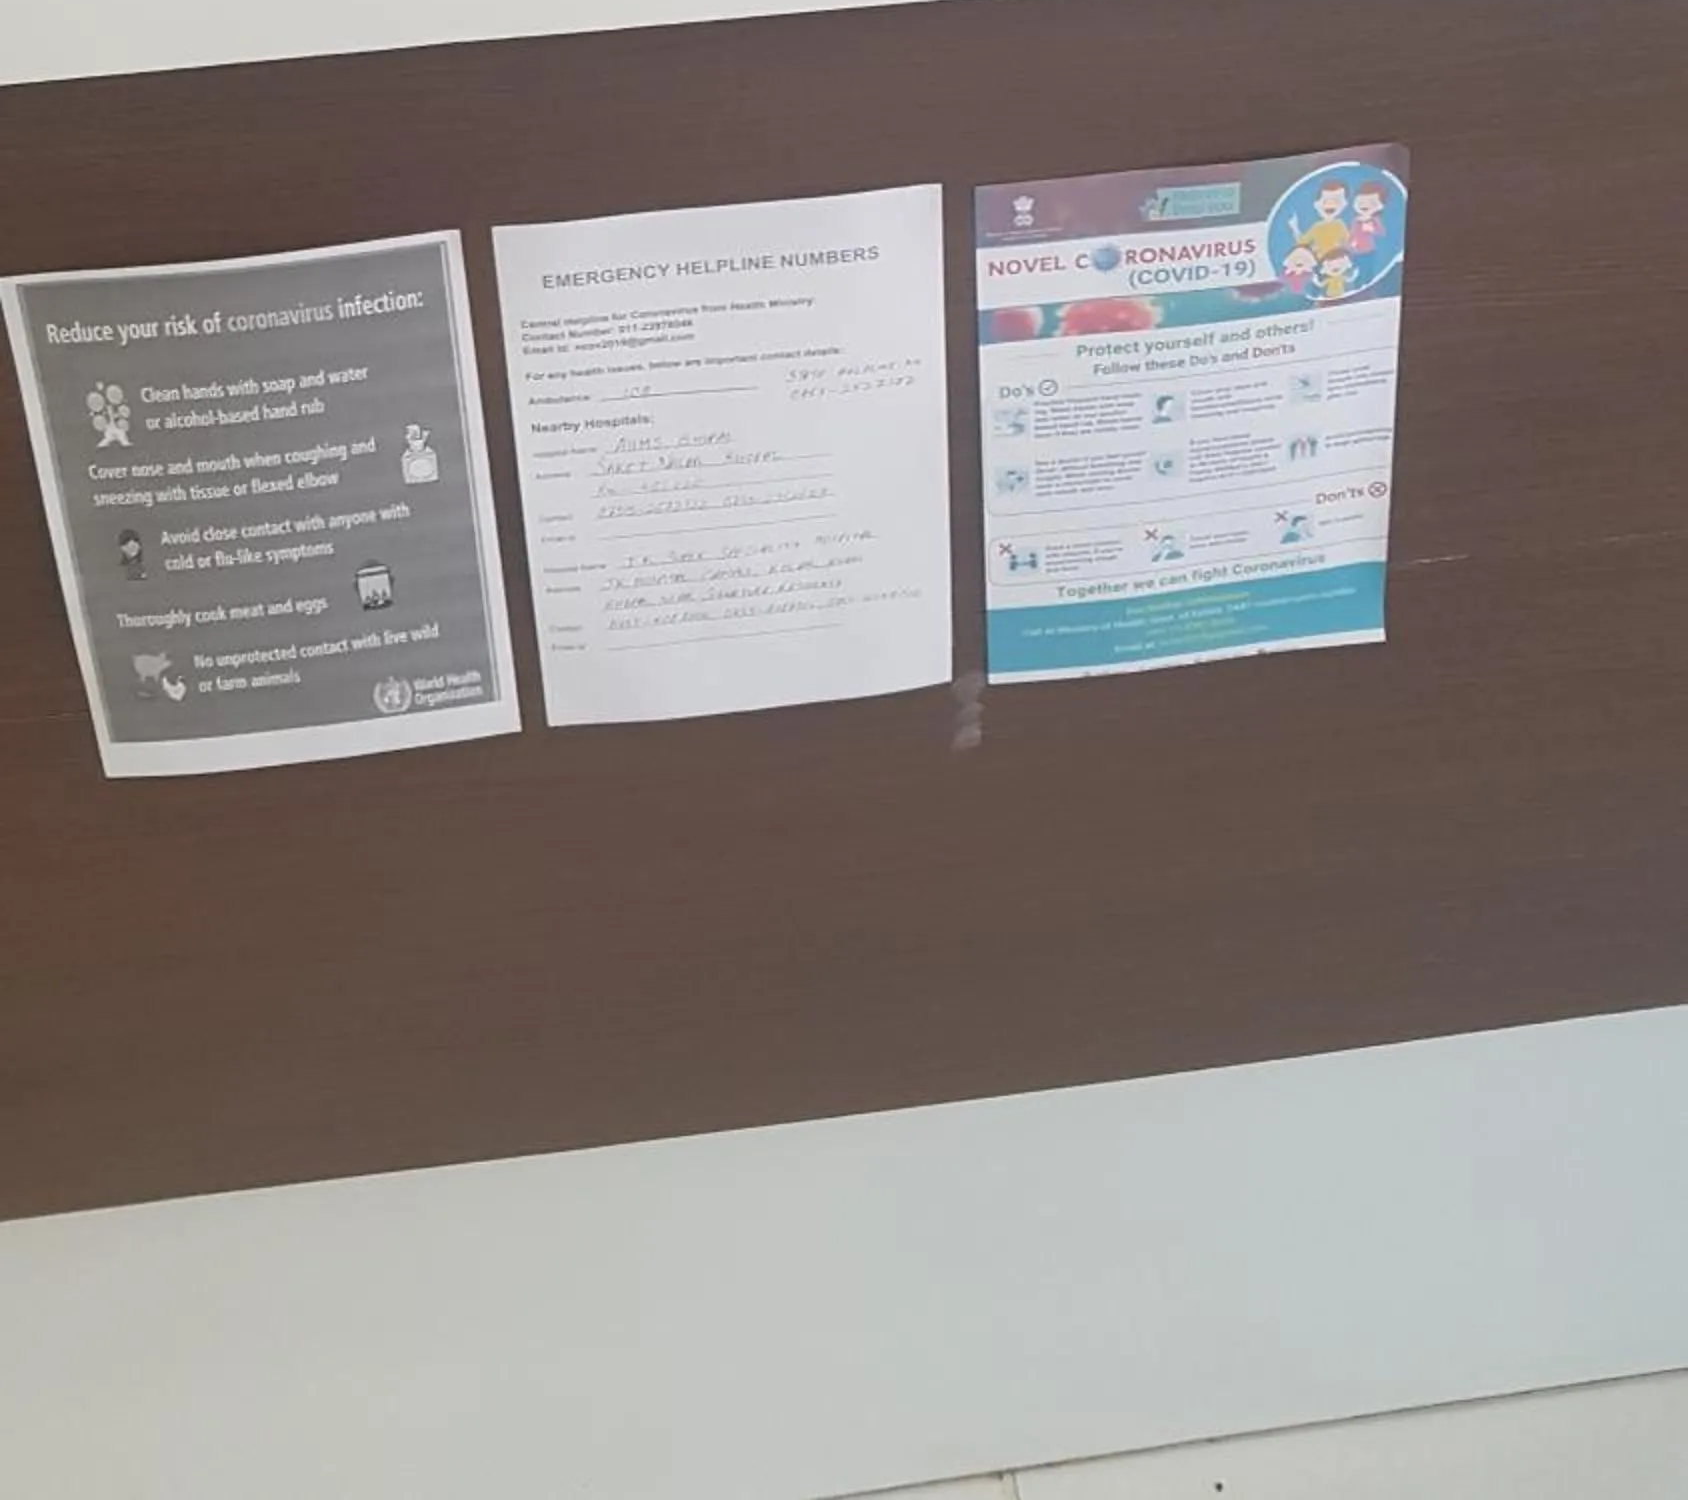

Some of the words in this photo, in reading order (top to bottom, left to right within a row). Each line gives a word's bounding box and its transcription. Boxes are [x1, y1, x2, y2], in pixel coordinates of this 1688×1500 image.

[542, 263, 670, 289] EMERGENCY
[676, 254, 775, 276] HELPLINE
[781, 246, 880, 268] NUMBERS
[988, 255, 1066, 277] NOVEL
[1129, 259, 1257, 291] (COVID-19)
[46, 322, 114, 345] Reduce
[119, 323, 161, 346] your
[165, 314, 198, 337] risk
[203, 311, 223, 334] of
[227, 303, 334, 333] coronavirus
[337, 291, 424, 320] infection:
[1076, 340, 1140, 358] Protect
[1144, 333, 1216, 357] yourself
[1220, 328, 1251, 344] and
[1255, 319, 1315, 338] others!
[1093, 360, 1141, 377] Follow
[1145, 356, 1186, 372] these
[1190, 352, 1219, 368] Do's
[1221, 349, 1249, 364] and
[141, 383, 180, 404] Clean
[183, 380, 224, 401] hands
[228, 376, 259, 398] with
[263, 376, 296, 397] soap
[300, 370, 325, 390] and
[329, 366, 369, 385] water
[1000, 384, 1035, 400] Do's
[146, 414, 161, 430] or
[165, 405, 259, 430] alcohol-based
[263, 400, 297, 420] hand
[301, 398, 325, 416] rub
[531, 421, 581, 436] Nearby
[89, 463, 128, 481] Cover
[131, 462, 164, 479] nose
[167, 457, 193, 476] and
[196, 453, 241, 474] mouth
[244, 449, 281, 470] when
[284, 443, 348, 468] coughing
[351, 437, 377, 456] and
[94, 488, 154, 508] sneezing
[156, 482, 186, 502] with
[190, 479, 230, 499] tissue
[234, 481, 248, 496] or
[252, 473, 294, 494] flexed
[297, 469, 339, 491] elbow
[160, 527, 199, 545] Avoid
[203, 523, 238, 543] close
[241, 520, 292, 540] contact
[296, 514, 326, 534] with
[329, 511, 376, 534] anyone
[379, 503, 411, 524] with
[165, 553, 194, 571] cold
[197, 555, 211, 570] or
[215, 546, 262, 567] flu-like
[266, 540, 334, 566] symptoms
[1057, 582, 1128, 601] Together
[1133, 577, 1154, 590] we
[1159, 574, 1188, 587] can
[1191, 566, 1229, 583] fight
[1232, 553, 1327, 576] Coronavirus
[117, 609, 191, 631] Thoroughly
[194, 604, 226, 624] cook
[230, 602, 265, 620] meat
[268, 598, 294, 616] and
[296, 597, 328, 617] eggs
[194, 653, 213, 669] No
[217, 644, 297, 669] unprotected
[300, 639, 349, 659] contact
[352, 632, 381, 652] with
[385, 629, 407, 647] live
[411, 622, 440, 643] wild
[199, 679, 213, 694] or
[216, 674, 247, 692] farm
[251, 668, 300, 689] animals
[414, 674, 446, 692] World
[448, 668, 482, 688] Health
[414, 683, 484, 706] Organization
